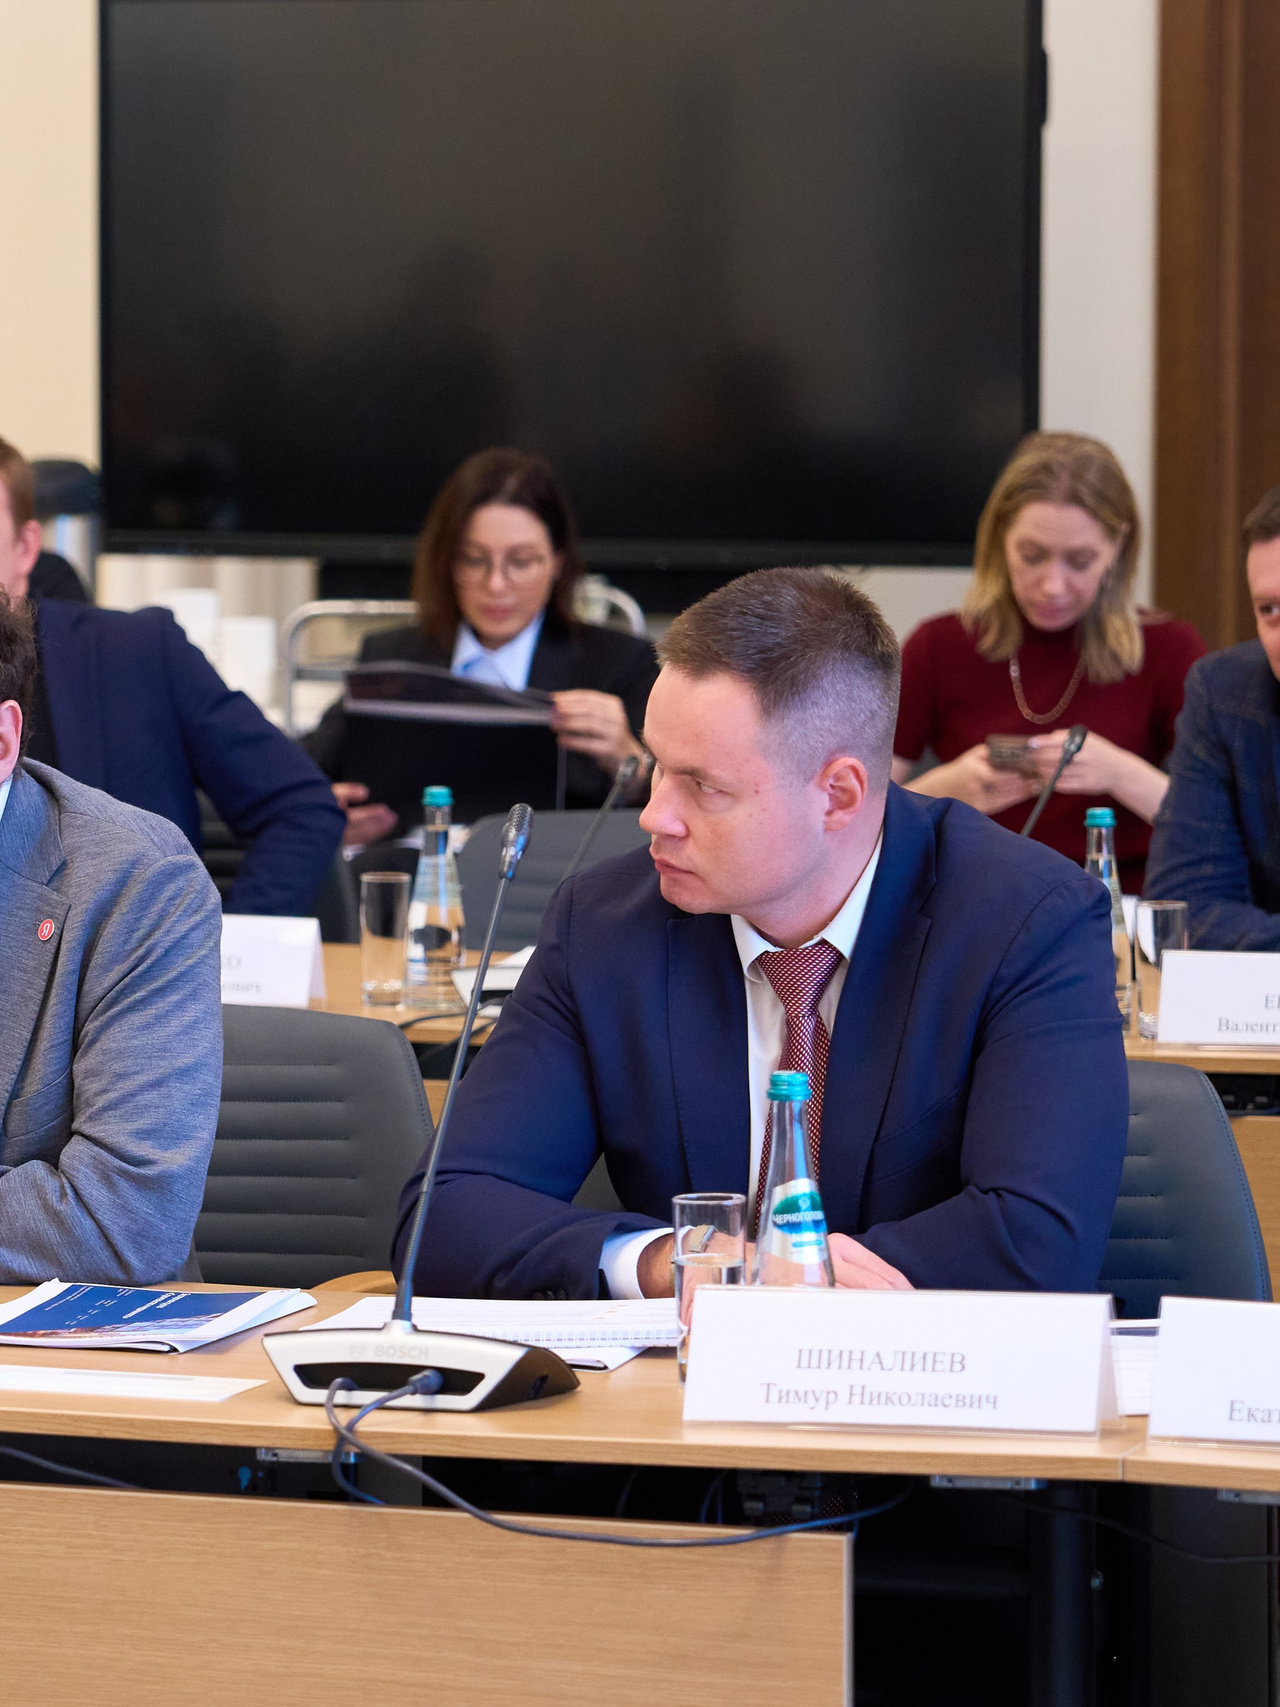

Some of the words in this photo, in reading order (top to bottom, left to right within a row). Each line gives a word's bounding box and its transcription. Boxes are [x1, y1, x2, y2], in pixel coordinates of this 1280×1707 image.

[773, 1210, 824, 1224] ЧЕРНОГОЛОВ
[374, 1344, 429, 1359] BOSCH
[795, 1348, 967, 1374] ШИНАЛИЕВ
[760, 1382, 839, 1412] Тимур
[847, 1383, 999, 1411] Николаевич
